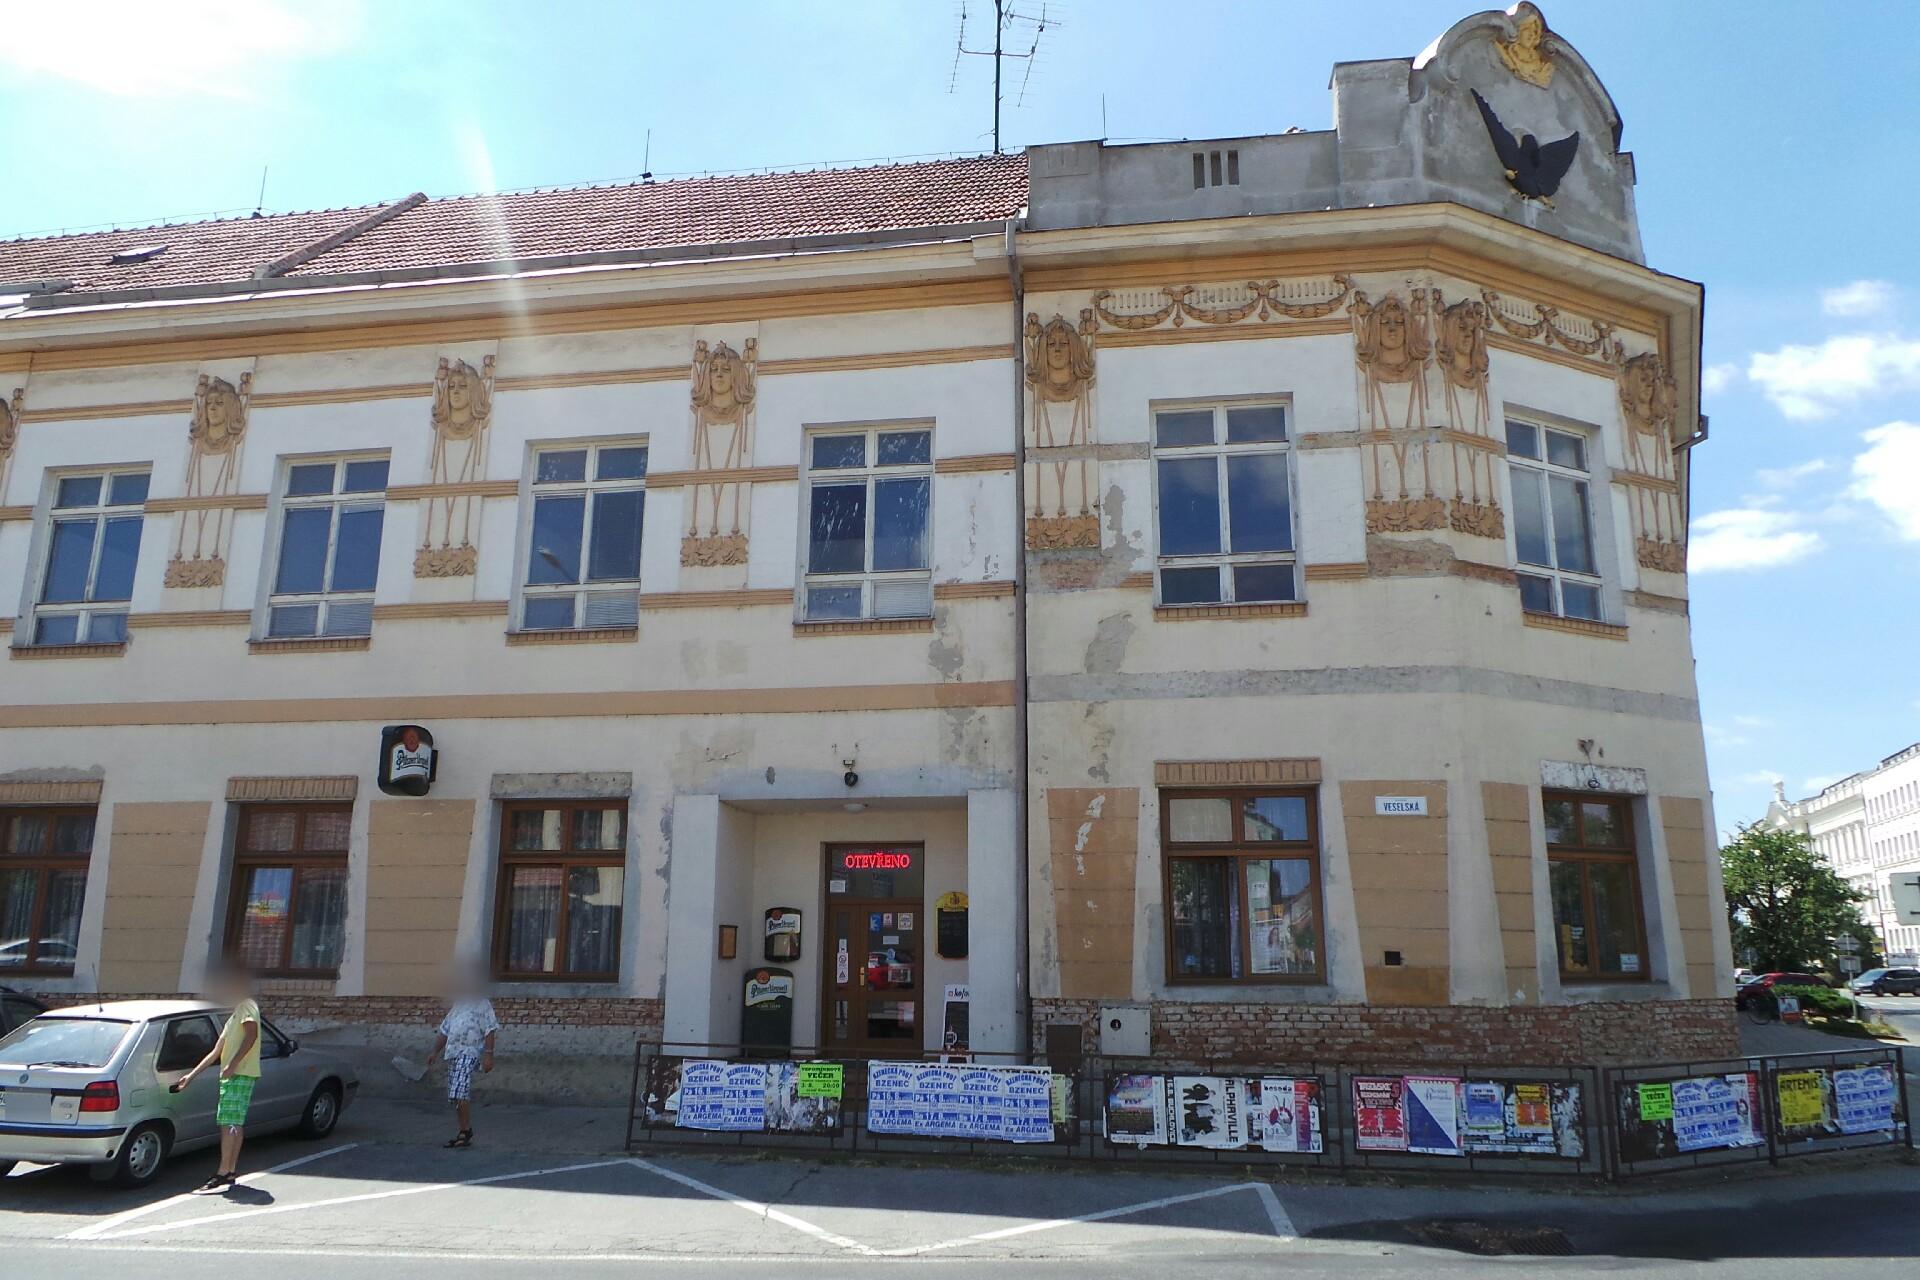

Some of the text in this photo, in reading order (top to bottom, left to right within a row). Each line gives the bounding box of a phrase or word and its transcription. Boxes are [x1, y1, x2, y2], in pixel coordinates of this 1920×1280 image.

[1384, 801, 1420, 812] VESELSKÁ
[845, 853, 911, 869] OTEVŘENO
[688, 1075, 721, 1083] BZENEC
[876, 1080, 909, 1088] BZENEC
[1780, 1078, 1819, 1090] ARTEMIS
[964, 1084, 999, 1092] BZENEC
[1225, 1080, 1239, 1143] ALPHAVILLE
